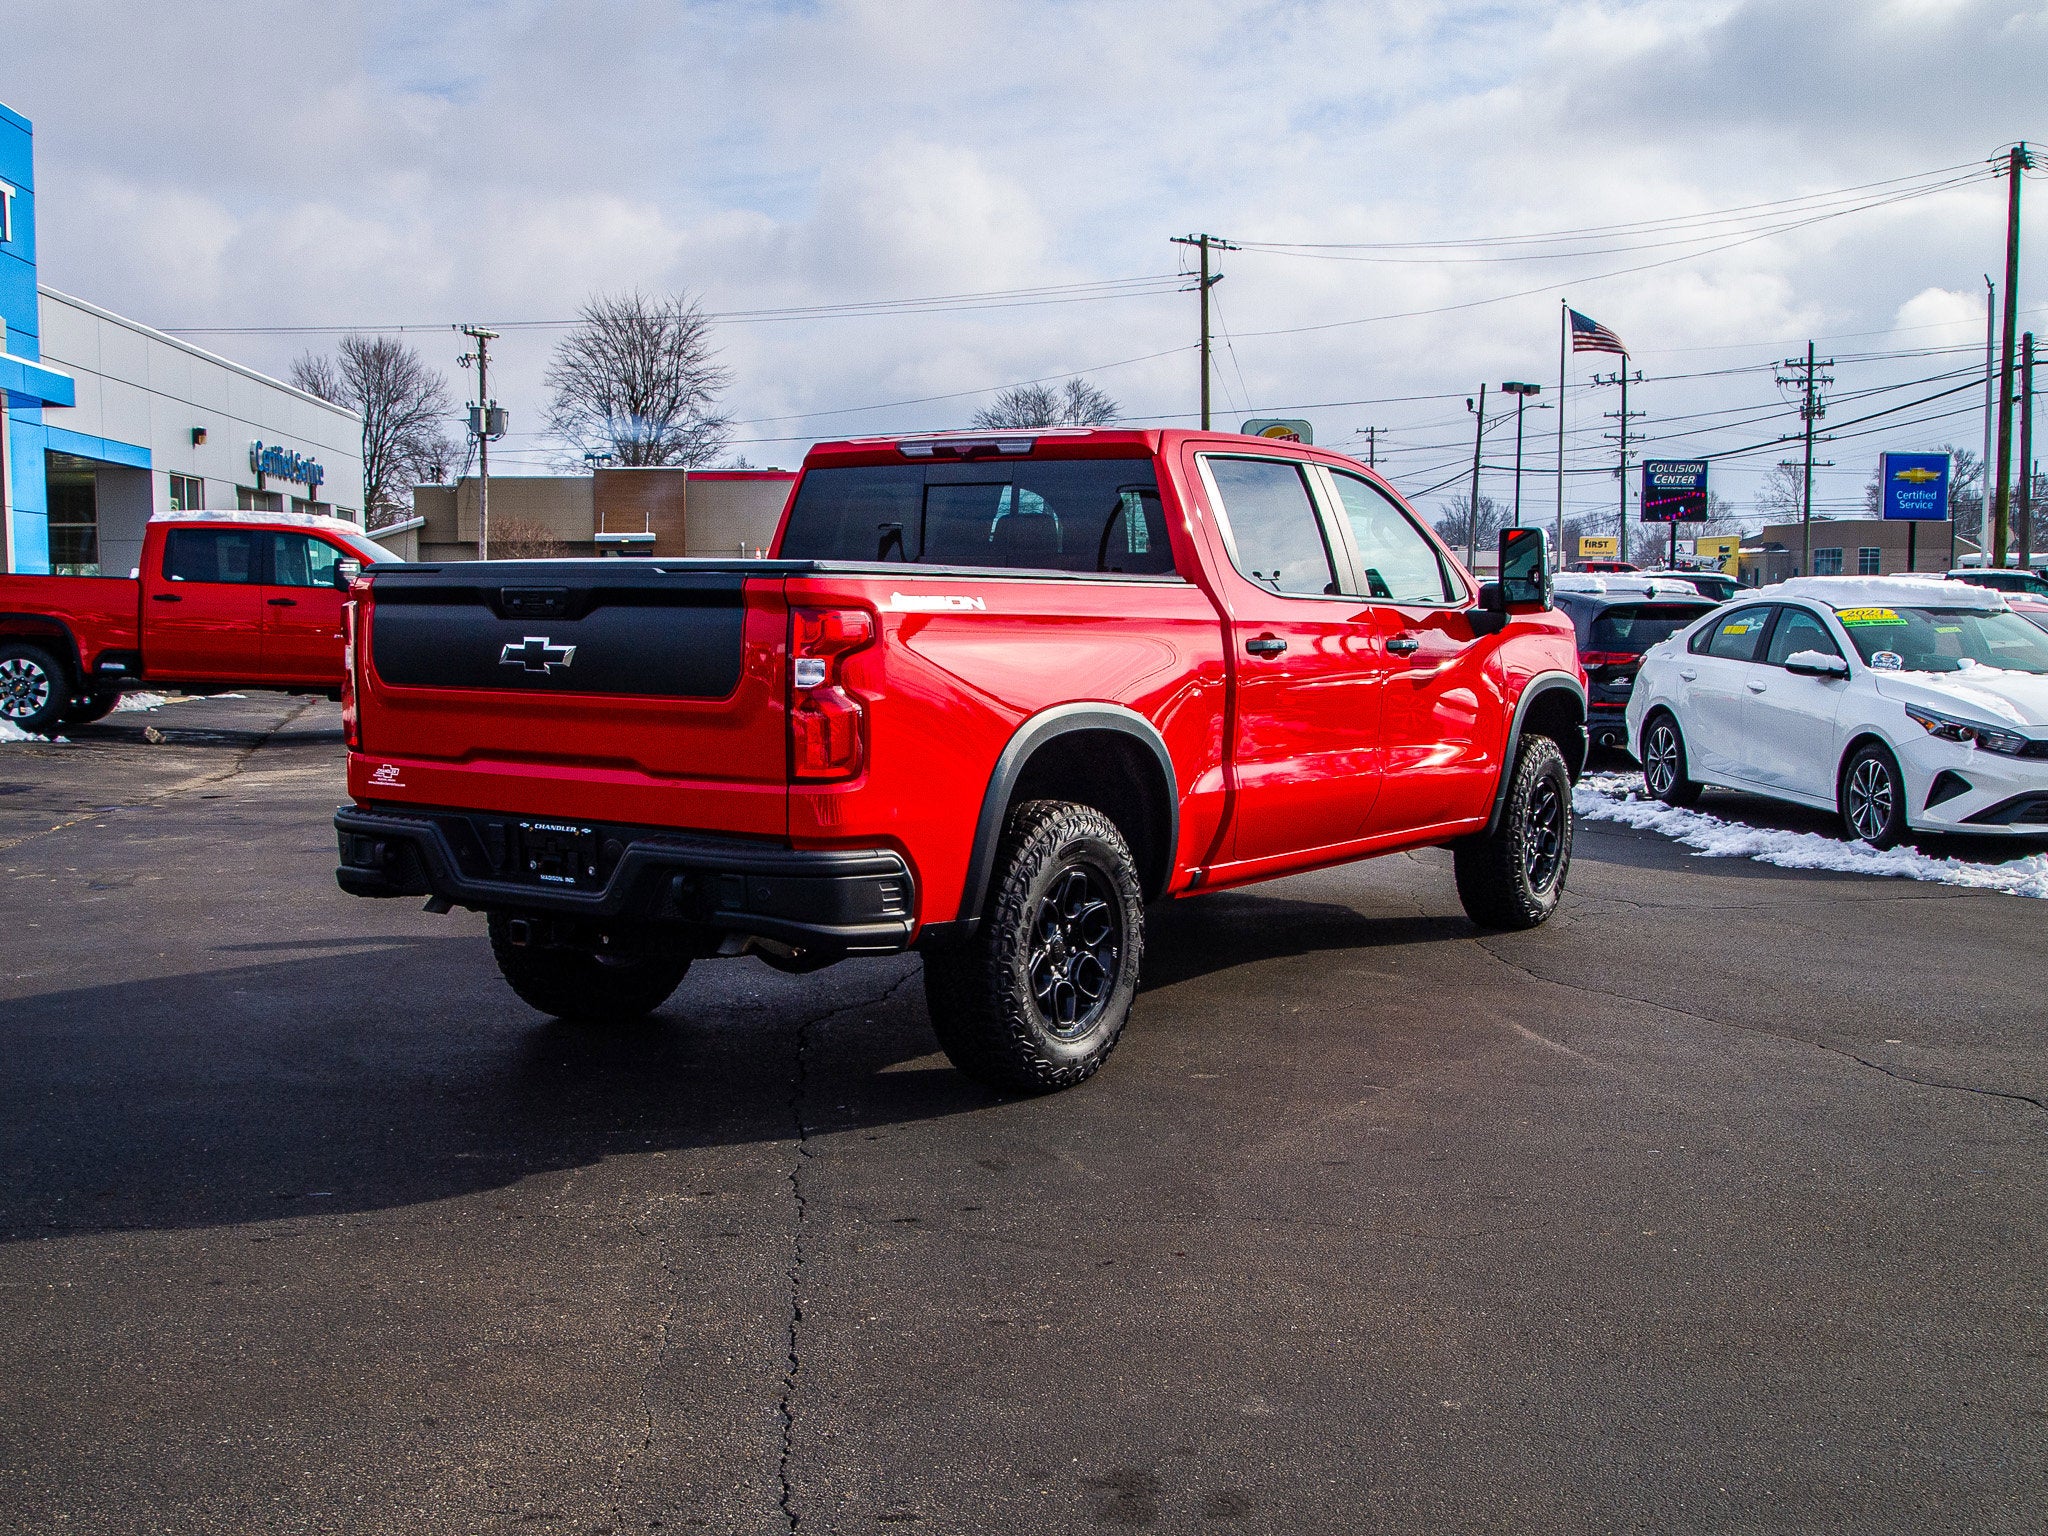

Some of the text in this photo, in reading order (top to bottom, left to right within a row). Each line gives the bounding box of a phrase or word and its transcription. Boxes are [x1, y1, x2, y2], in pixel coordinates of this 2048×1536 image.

[251, 440, 324, 486] Certified Service
[1648, 463, 1704, 473] COLLISION
[1653, 474, 1696, 484] CENTER
[1896, 490, 1937, 500] Certified
[1899, 500, 1934, 510] Service
[534, 823, 577, 832] CHANDLER
